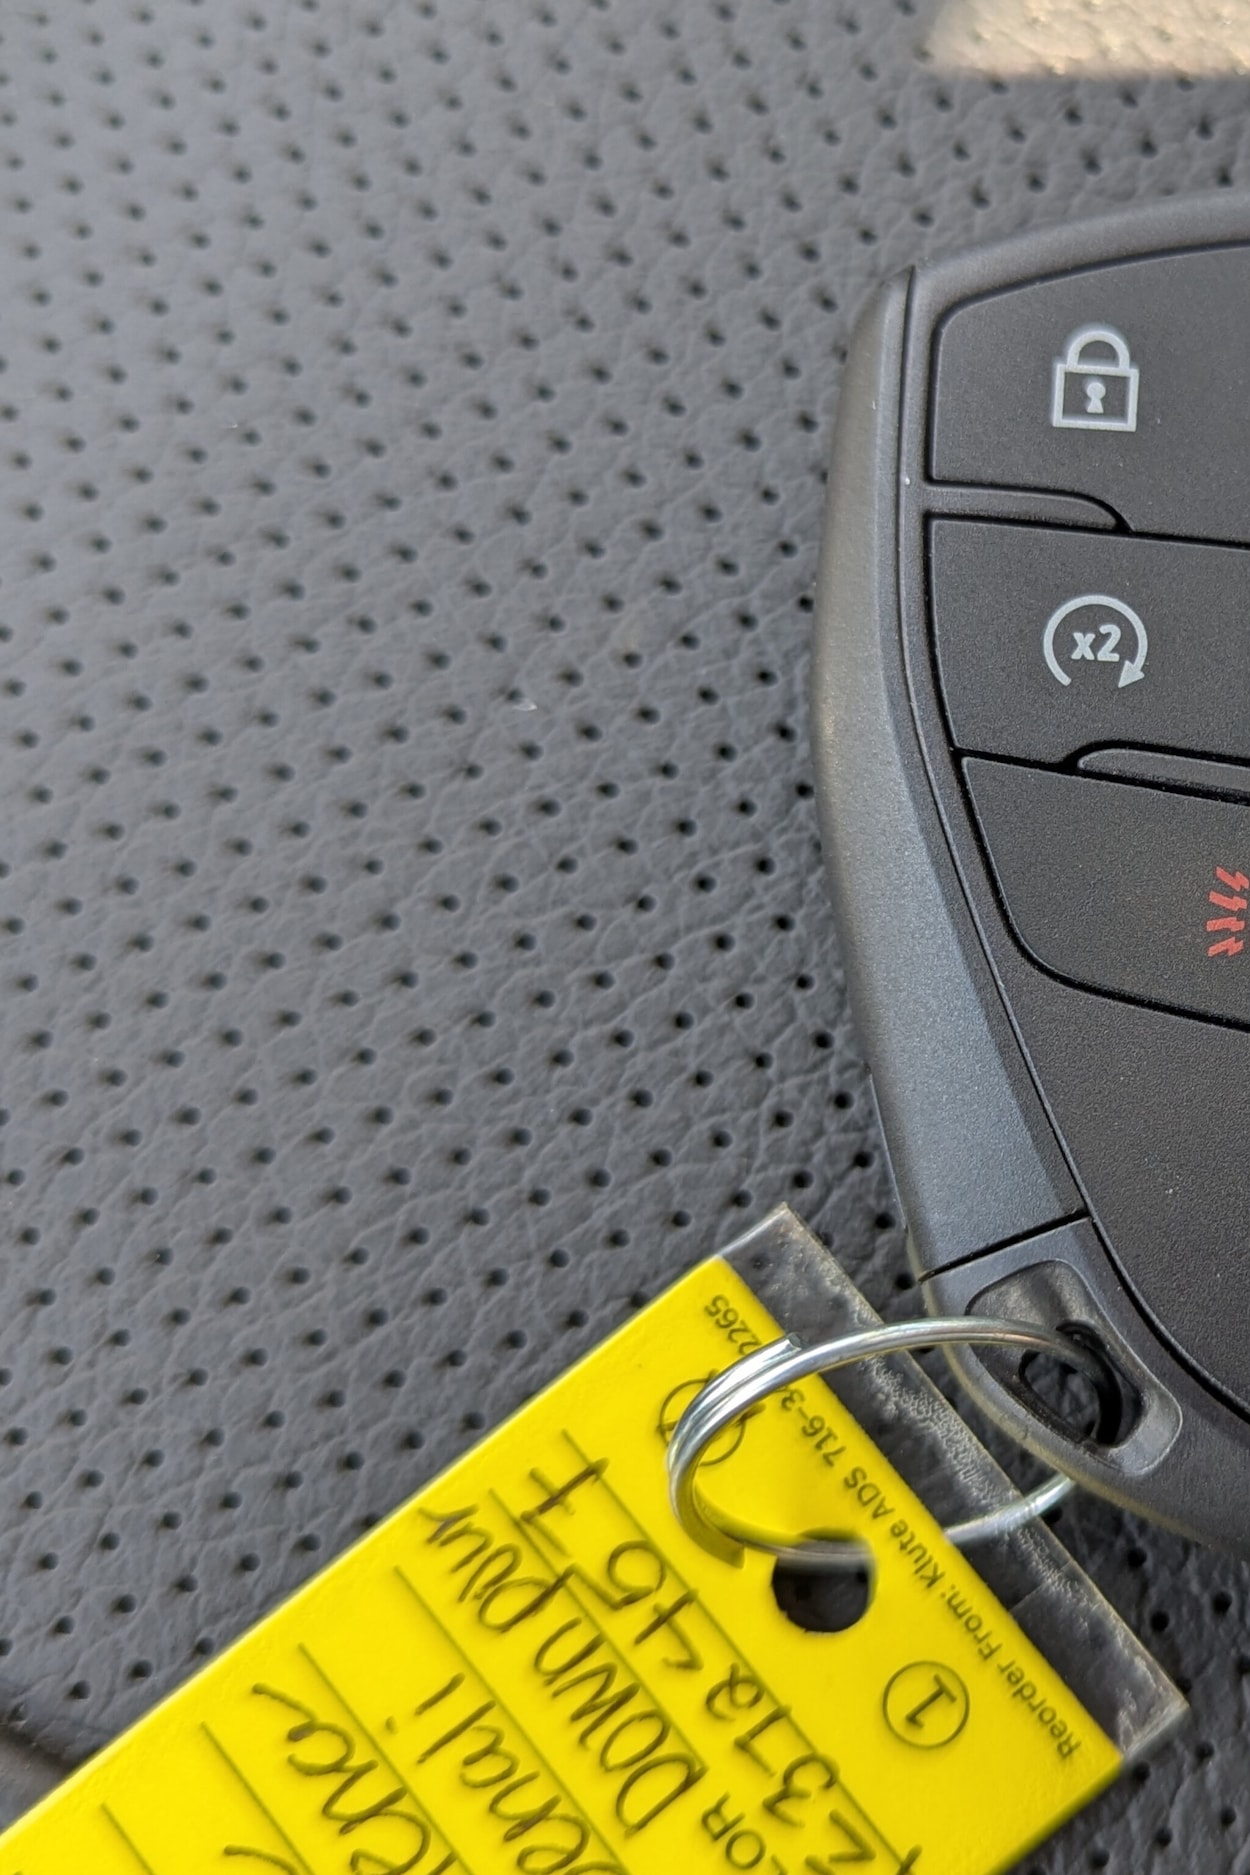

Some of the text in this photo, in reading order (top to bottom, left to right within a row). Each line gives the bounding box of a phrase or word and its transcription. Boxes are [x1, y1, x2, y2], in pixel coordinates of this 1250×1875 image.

[1070, 624, 1122, 662] x2
[843, 1466, 896, 1522] ADS
[889, 1519, 946, 1591] Klute
[939, 1582, 1003, 1663] From:
[904, 1673, 958, 1731] 1
[997, 1658, 1083, 1761] Reorder
[386, 1672, 628, 1875] enali
